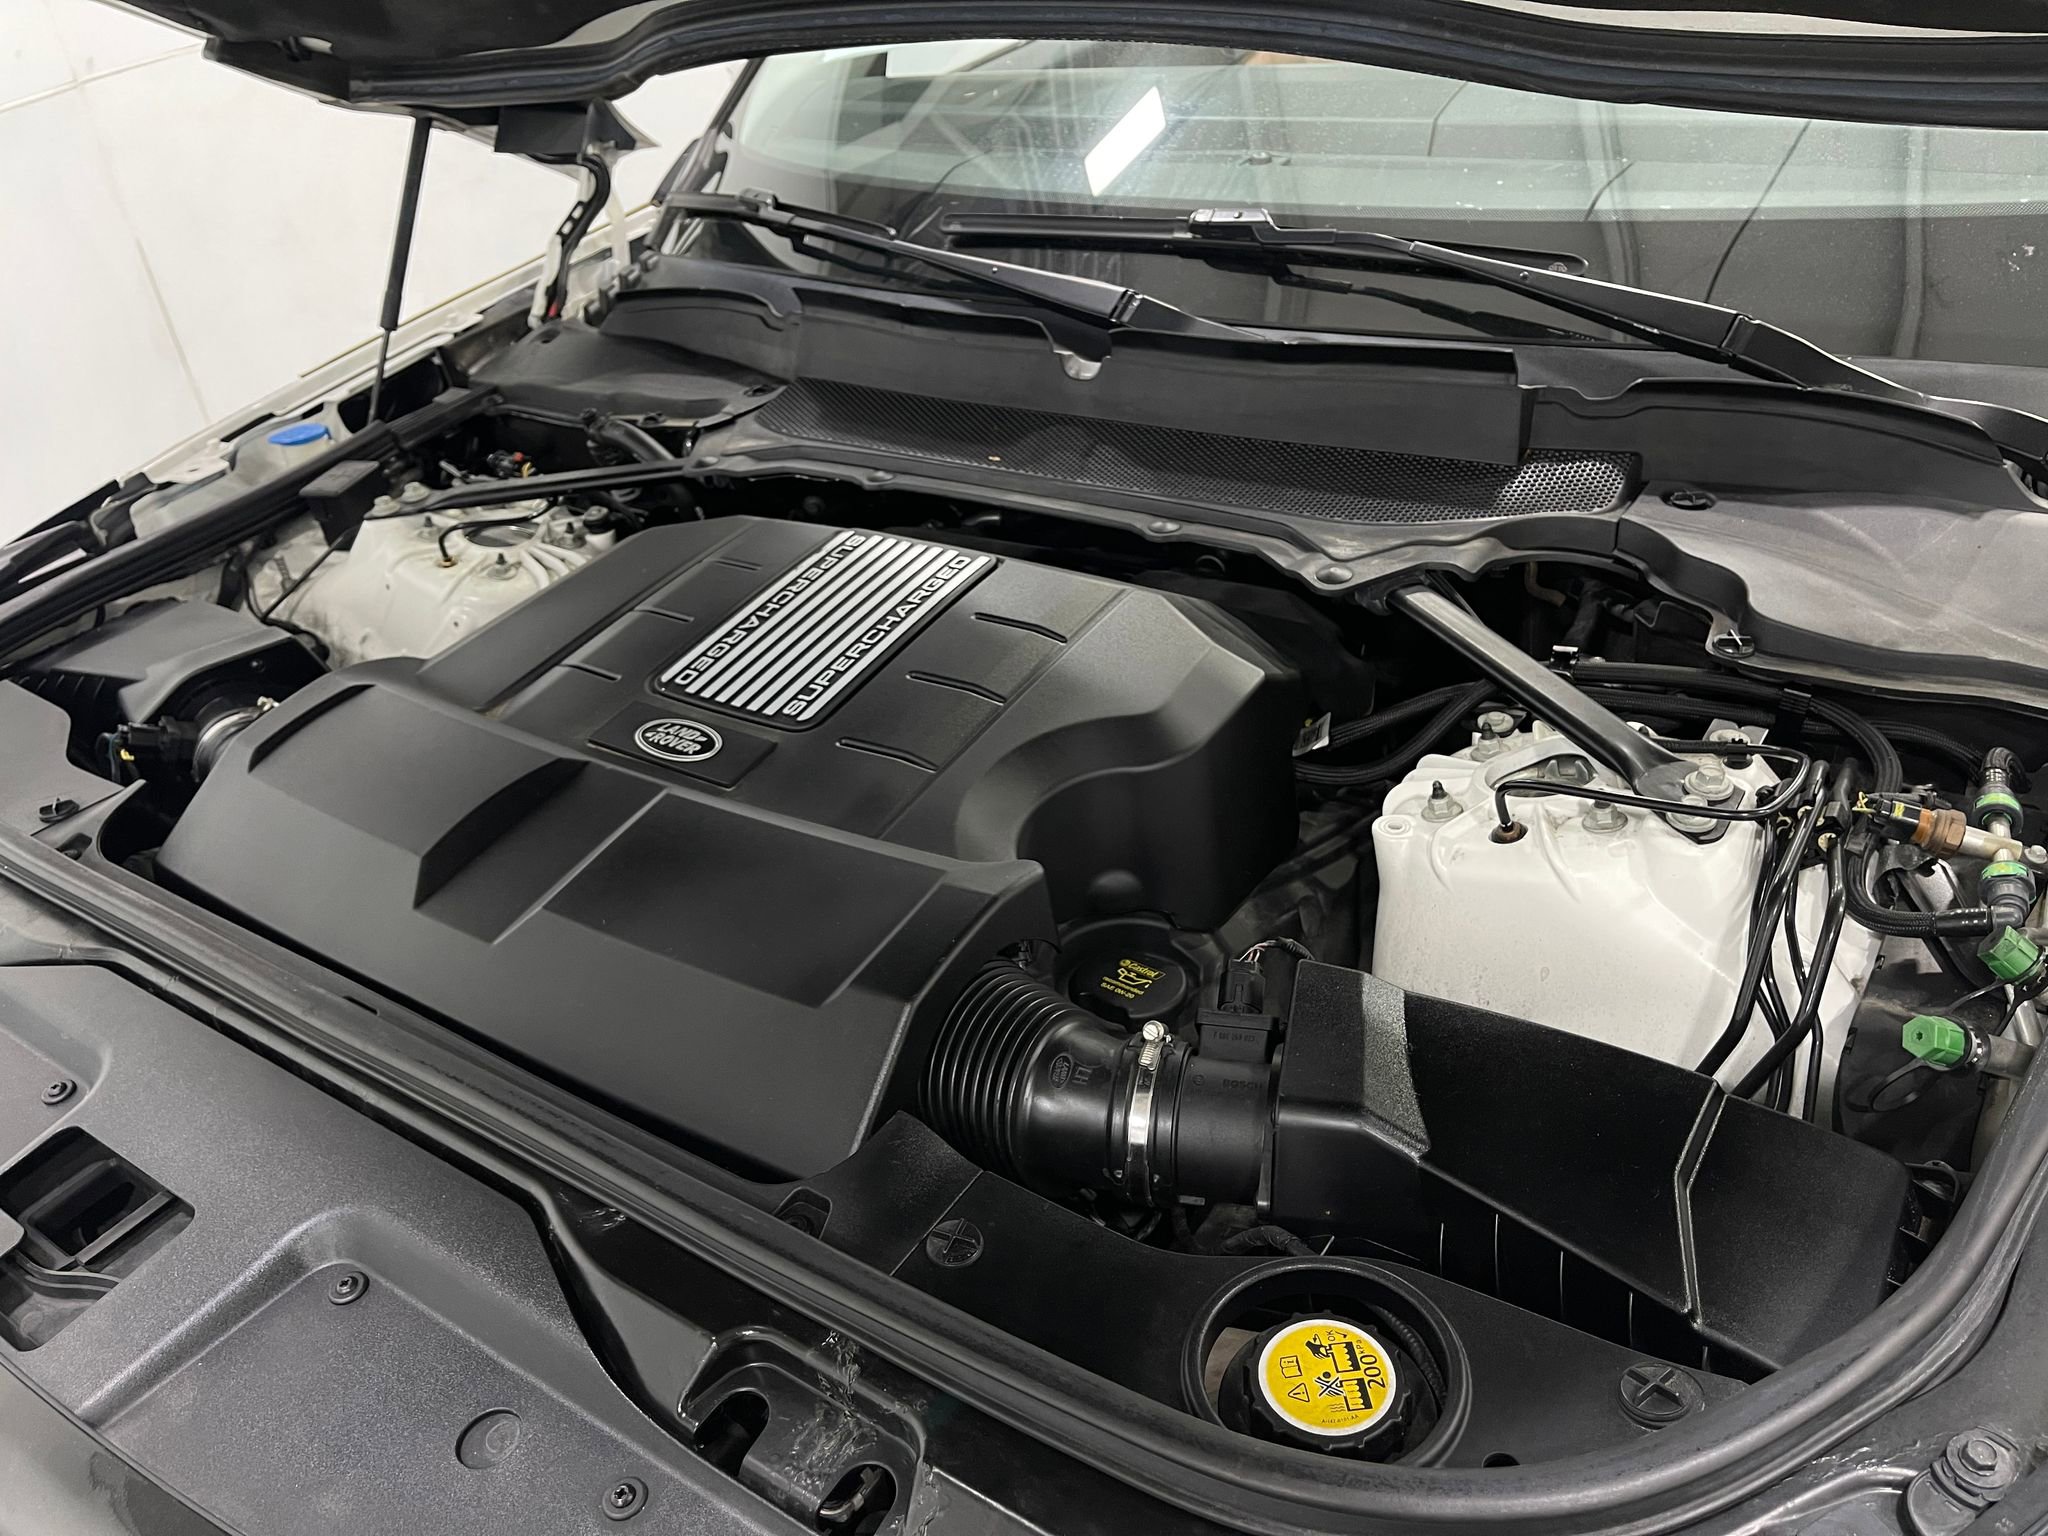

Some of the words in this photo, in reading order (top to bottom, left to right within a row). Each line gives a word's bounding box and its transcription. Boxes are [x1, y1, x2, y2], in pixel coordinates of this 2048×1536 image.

[673, 533, 867, 686] SUPERCHARGED
[782, 554, 972, 717] SUPERCHARGED
[657, 722, 702, 740] LAND
[648, 732, 702, 755] ROVER
[1128, 963, 1160, 979] Castrol
[1071, 1066, 1092, 1085] LH
[1222, 1078, 1263, 1090] BOSCH
[1325, 1329, 1336, 1342] OK
[1360, 1354, 1386, 1389] 200
